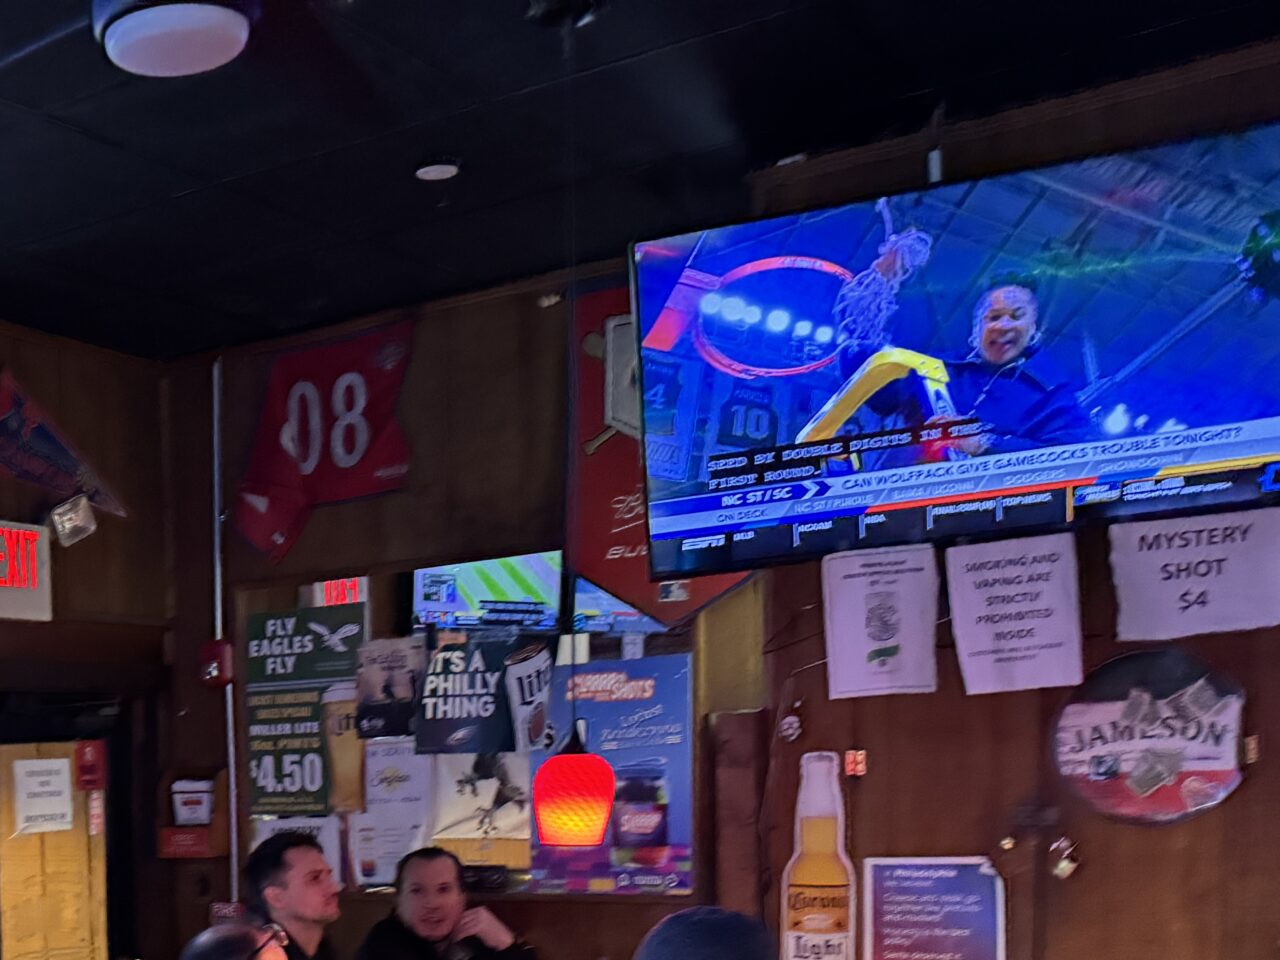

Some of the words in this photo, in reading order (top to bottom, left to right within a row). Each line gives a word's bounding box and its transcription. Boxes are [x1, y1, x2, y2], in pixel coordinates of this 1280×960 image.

[1137, 522, 1254, 553] MYSTERY
[1160, 557, 1228, 581] SHOT
[1178, 588, 1210, 614] $4
[265, 616, 297, 638] FLY
[248, 635, 315, 658] EAGLES
[265, 655, 297, 676] FLY
[428, 650, 466, 674] IT'S
[468, 648, 487, 673] A
[423, 671, 501, 697] PHILLY
[421, 695, 497, 719] THING
[1069, 714, 1229, 754] JAMESON
[249, 751, 324, 793] $4.50
